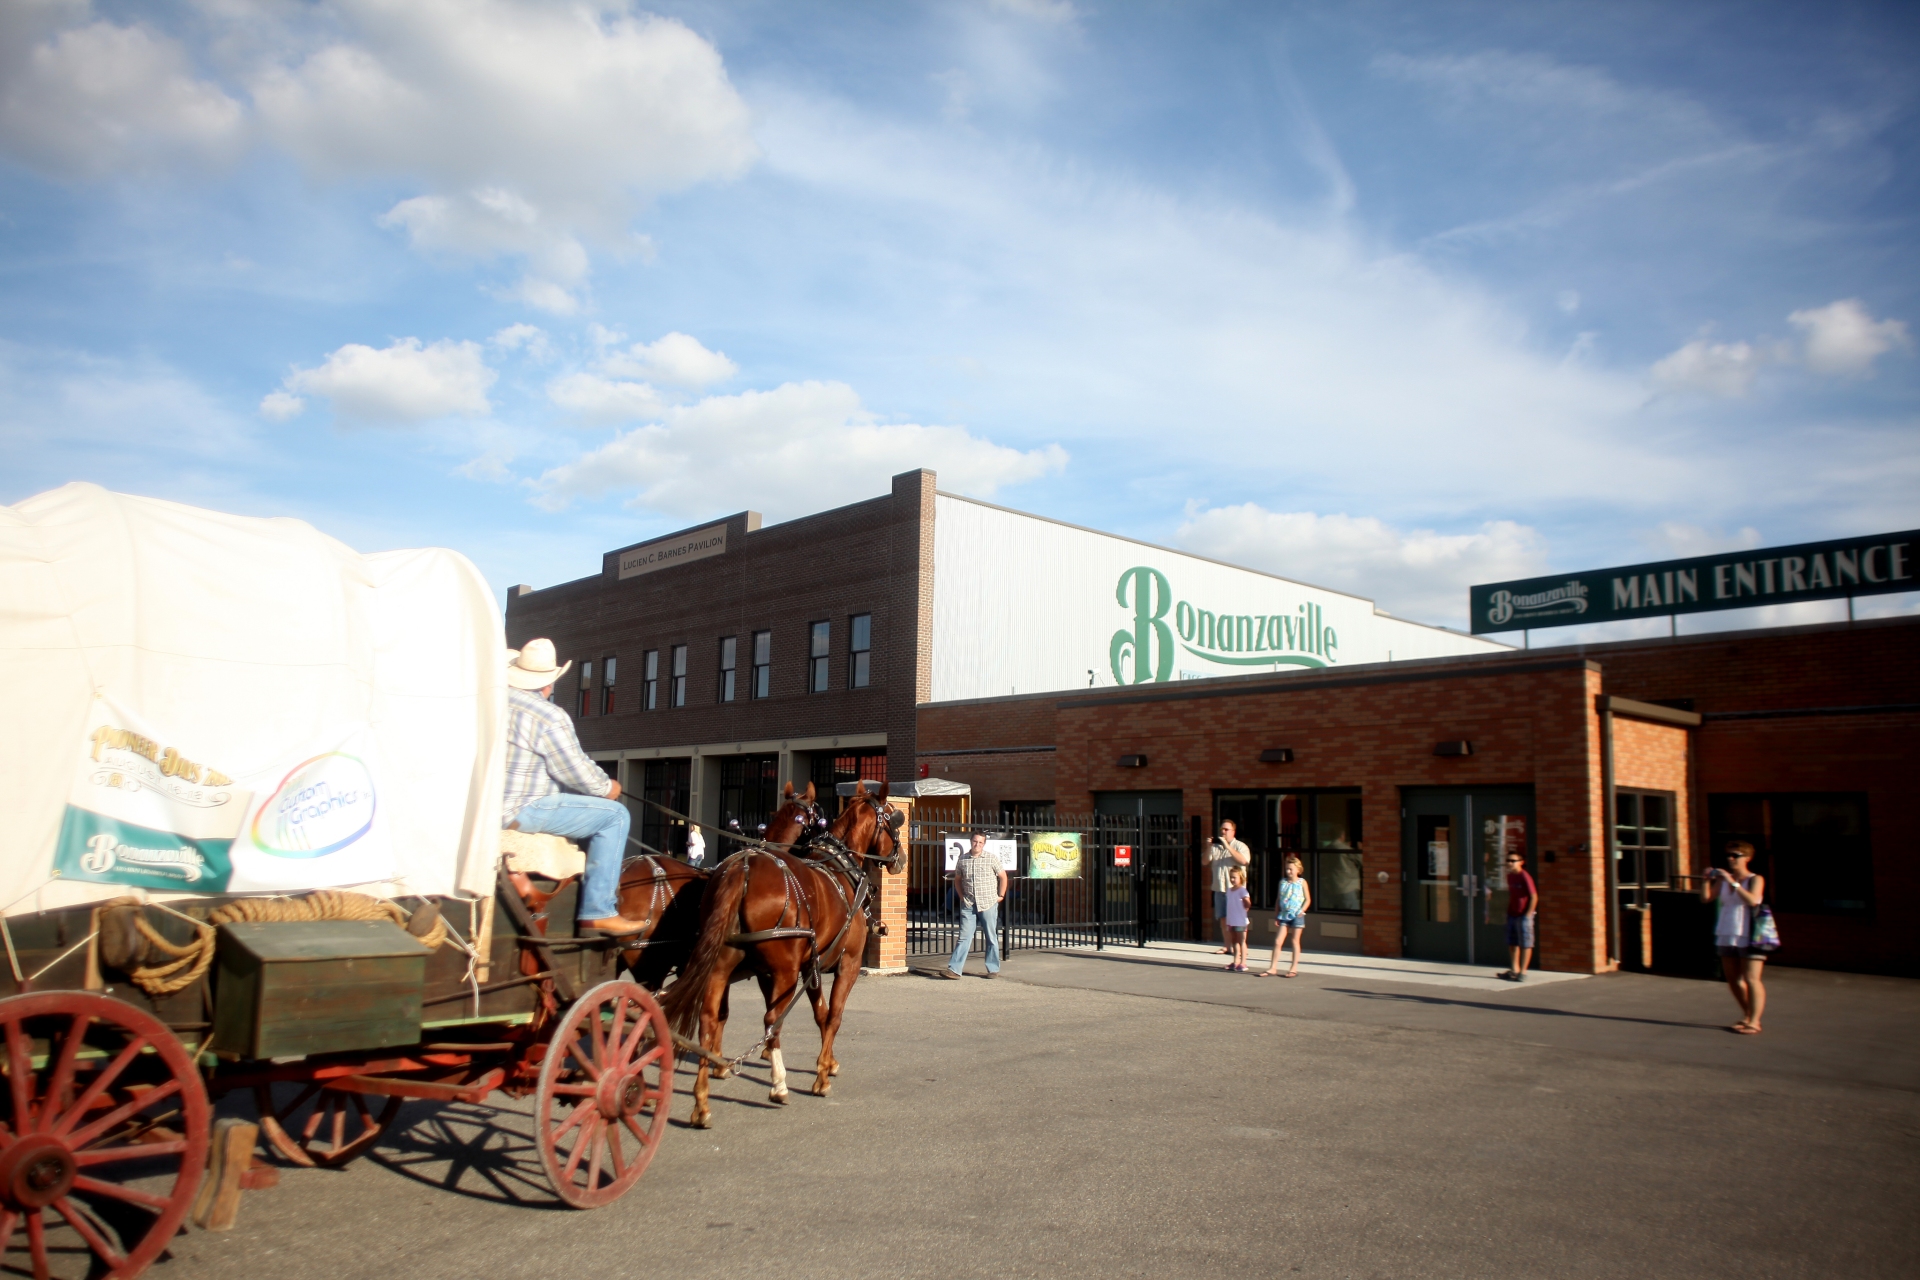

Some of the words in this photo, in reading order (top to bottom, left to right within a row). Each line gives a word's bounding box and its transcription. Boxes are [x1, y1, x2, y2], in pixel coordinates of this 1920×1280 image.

[623, 556, 647, 571] LUCIEN
[648, 553, 656, 564] C.
[657, 545, 687, 561] BARNES
[688, 536, 723, 553] PAVILION
[1611, 567, 1699, 611] MAIN
[1714, 543, 1912, 600] ENTRANCE
[1488, 580, 1589, 625] Bonanzaville
[1110, 565, 1338, 686] Bonanzaville
[104, 757, 163, 784] AUGUST
[278, 780, 329, 814] Custom
[289, 786, 359, 825] Graphics
[80, 834, 205, 875] Bonanzaville
